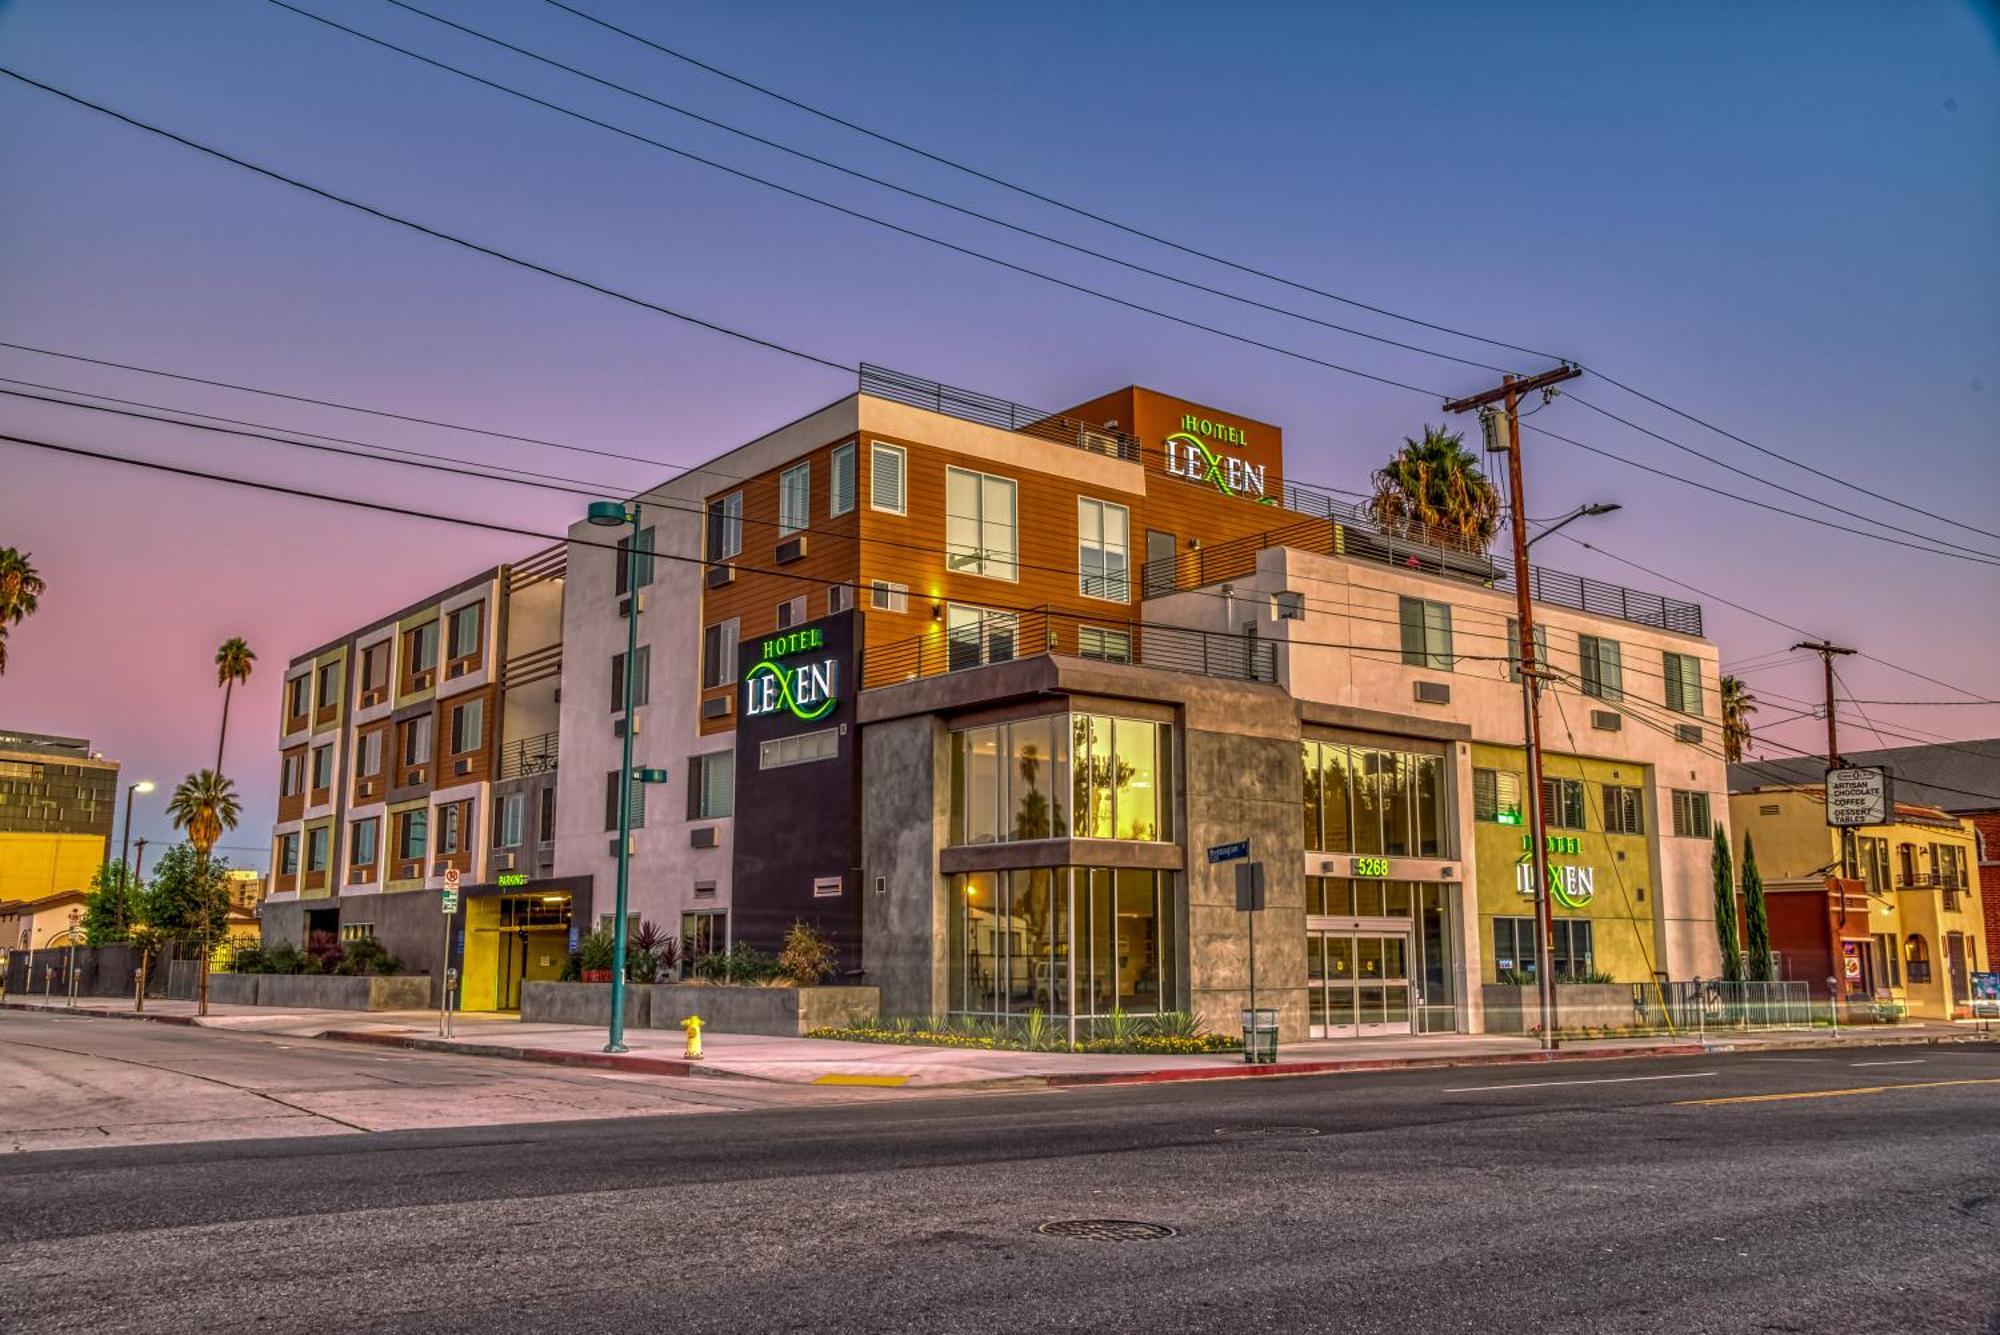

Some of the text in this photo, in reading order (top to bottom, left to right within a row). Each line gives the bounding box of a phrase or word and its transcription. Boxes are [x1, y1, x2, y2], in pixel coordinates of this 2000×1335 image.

[1183, 414, 1247, 446] HOTEL
[1166, 434, 1265, 496] LEXEN
[763, 629, 818, 659] HOTEL
[746, 659, 837, 719] LEXEN
[1834, 781, 1867, 789] ARTISAN
[1834, 788, 1880, 797] CHOCOLATE
[1834, 798, 1865, 806] COFFEE
[1834, 808, 1870, 816] DESSERT
[1835, 815, 1865, 823] TABLES
[1359, 858, 1387, 876] 5268
[1518, 858, 1593, 905] LXEN
